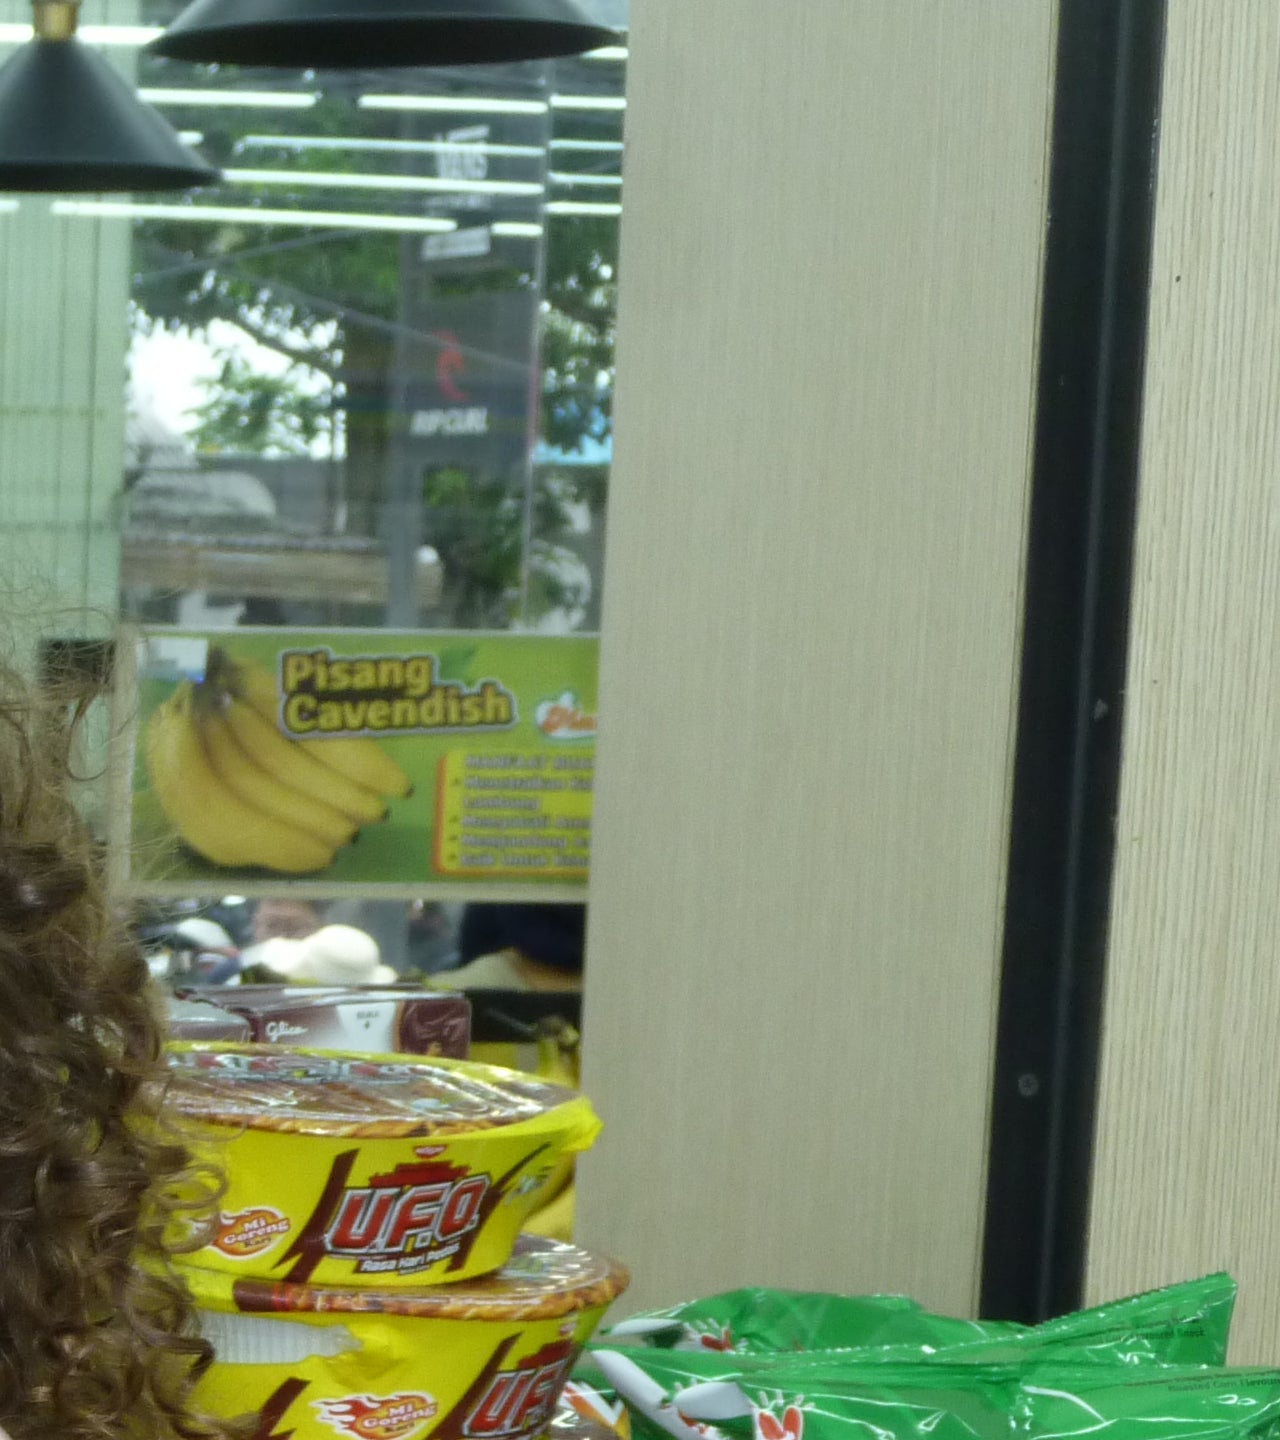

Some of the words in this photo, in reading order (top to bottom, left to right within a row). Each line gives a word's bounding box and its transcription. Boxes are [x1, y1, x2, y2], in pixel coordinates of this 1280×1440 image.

[284, 651, 433, 695] Pisang
[284, 682, 514, 730] Cavendish
[266, 1022, 307, 1043] Glico
[223, 1218, 290, 1244] Goreng
[244, 1218, 266, 1231] Mi
[363, 1403, 437, 1428] Goreng
[390, 1403, 414, 1416] Mi
